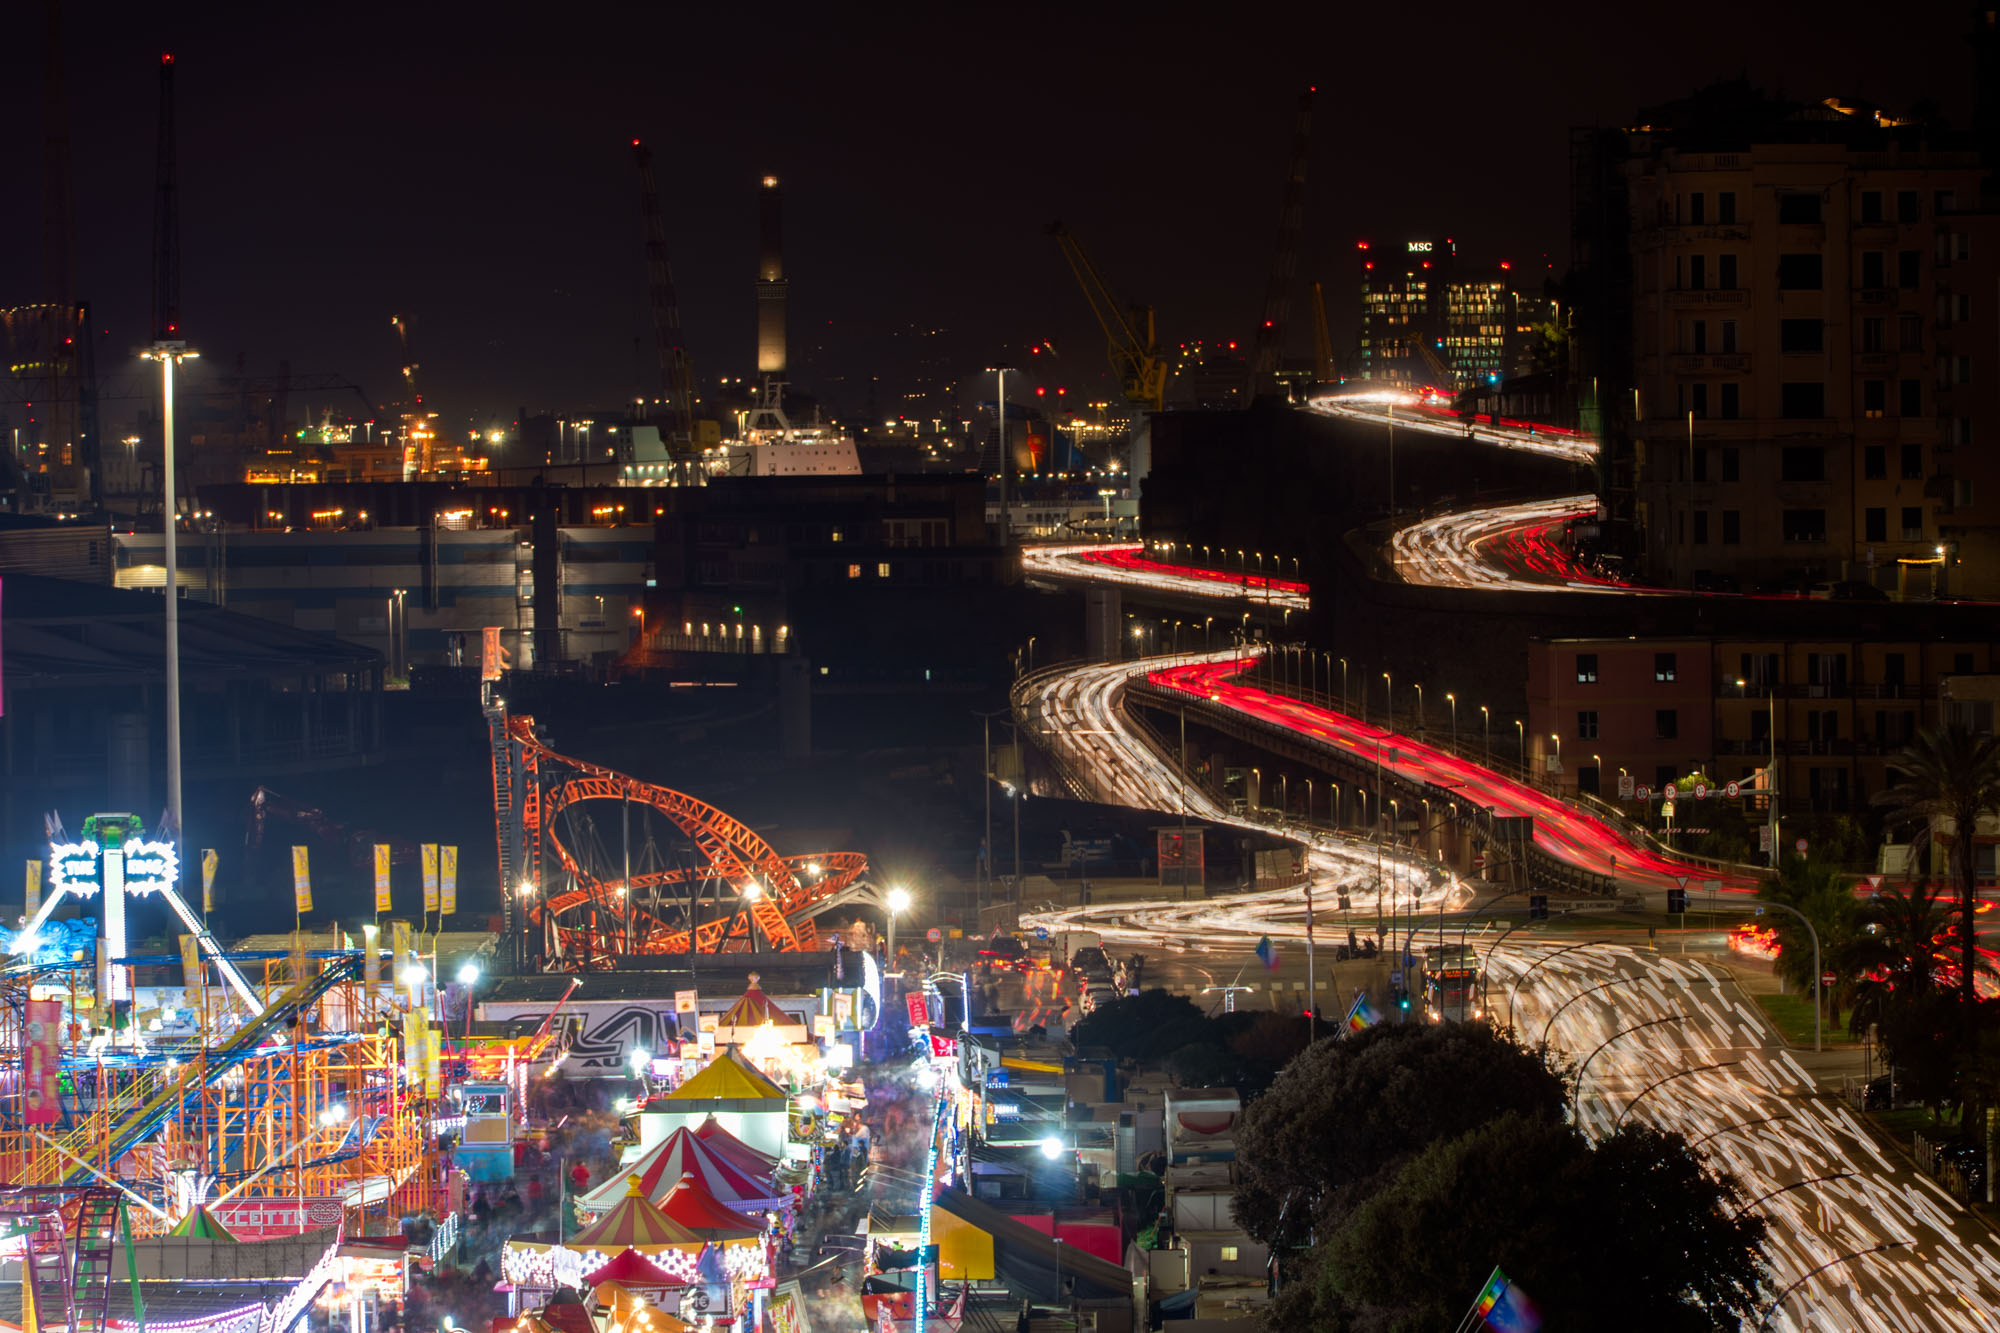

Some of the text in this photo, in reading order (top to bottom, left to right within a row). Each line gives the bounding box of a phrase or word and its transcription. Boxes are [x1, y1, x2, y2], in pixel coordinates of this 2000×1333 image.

[1408, 241, 1433, 252] MSC
[65, 859, 164, 876] THE KING
